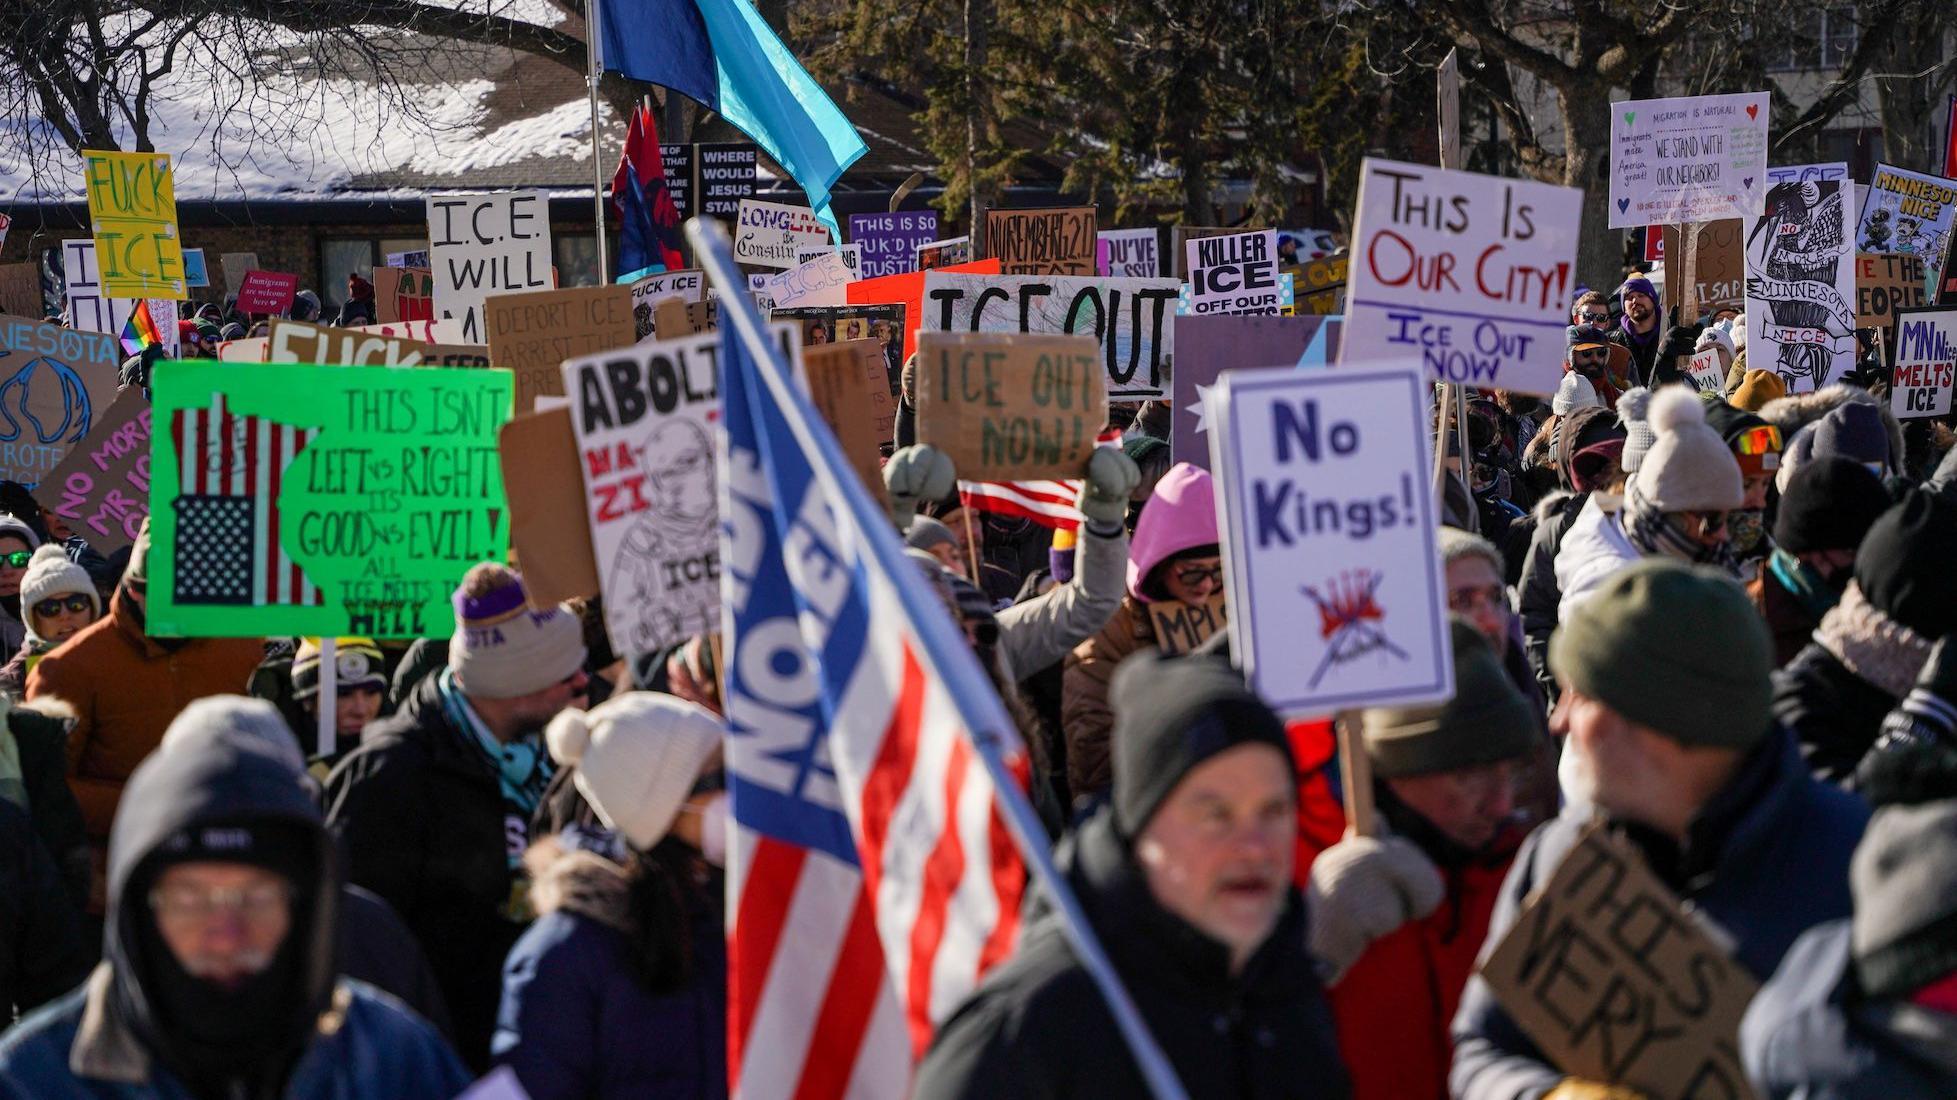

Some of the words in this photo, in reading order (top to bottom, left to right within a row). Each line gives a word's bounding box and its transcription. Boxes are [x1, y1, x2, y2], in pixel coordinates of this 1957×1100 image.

[1653, 110, 1687, 122] MIGRATION
[1693, 109, 1700, 118] IS
[1619, 132, 1652, 147] Immigrants
[1655, 138, 1669, 159] WE
[1672, 135, 1698, 158] STAND
[1701, 134, 1723, 156] WITH
[666, 158, 687, 166] THAT
[703, 151, 754, 163] WHERE
[1618, 160, 1647, 174] America
[88, 157, 174, 216] FUCK
[670, 179, 688, 187] ARE
[703, 167, 755, 179] WOULD
[1624, 171, 1647, 187] great!
[1656, 166, 1675, 186] OUR
[1676, 162, 1720, 185] NEIGHBORS!
[707, 184, 752, 196] JESUS
[1371, 168, 1470, 234] THIS
[1502, 186, 1535, 240] IS
[706, 201, 740, 213] STAN
[742, 206, 790, 230] LONG
[1900, 197, 1942, 222] NICE
[432, 196, 541, 247] I.C.E.
[855, 217, 894, 232] THIS
[900, 217, 913, 230] IS
[918, 216, 937, 230] SO
[1780, 223, 1798, 235] NO
[96, 232, 180, 281] ICE
[1108, 237, 1155, 264] OU'VE
[1198, 233, 1267, 268] KILLER
[1778, 249, 1825, 265] MORE
[249, 276, 289, 288] Immigrants
[448, 251, 545, 291] WILL
[770, 257, 845, 305] ICE
[1193, 261, 1275, 296] ICE
[1368, 229, 1462, 293] OUR
[1475, 243, 1571, 311] CITY!
[1881, 254, 1927, 282] THE
[253, 297, 269, 306] here
[258, 288, 287, 297] welcome
[632, 280, 664, 299] FUCK
[671, 277, 698, 290] ICE
[1760, 280, 1849, 324] MINNESOTA
[1195, 299, 1232, 313] OFF
[1235, 294, 1277, 308] OUR
[496, 300, 573, 337] DEPORT
[271, 322, 423, 367] FUCK
[1064, 284, 1180, 388] OUT
[1387, 313, 1453, 347] ICE
[1474, 320, 1535, 362] OUT
[1774, 329, 1826, 344] NICE
[1901, 321, 1935, 361] MN
[502, 336, 573, 370] ARREST
[1424, 350, 1502, 384] NOW
[938, 350, 1007, 408] ICE
[1031, 352, 1096, 411] OUT
[1893, 363, 1953, 387] MELTS
[344, 388, 417, 434] THIS
[424, 384, 506, 436] ISN'T
[1906, 387, 1938, 411] ICE
[981, 415, 1086, 468] NOW!
[1270, 398, 1361, 465] No
[307, 447, 373, 497] LEFT
[400, 446, 499, 499] RIGHT
[55, 472, 95, 520] NO
[1253, 472, 1418, 549] Kings!
[298, 510, 377, 558] GOOD
[410, 508, 502, 561] EVIL!
[362, 556, 402, 579] ALL
[661, 550, 720, 592] ICE
[1517, 902, 1685, 1084] VERY
